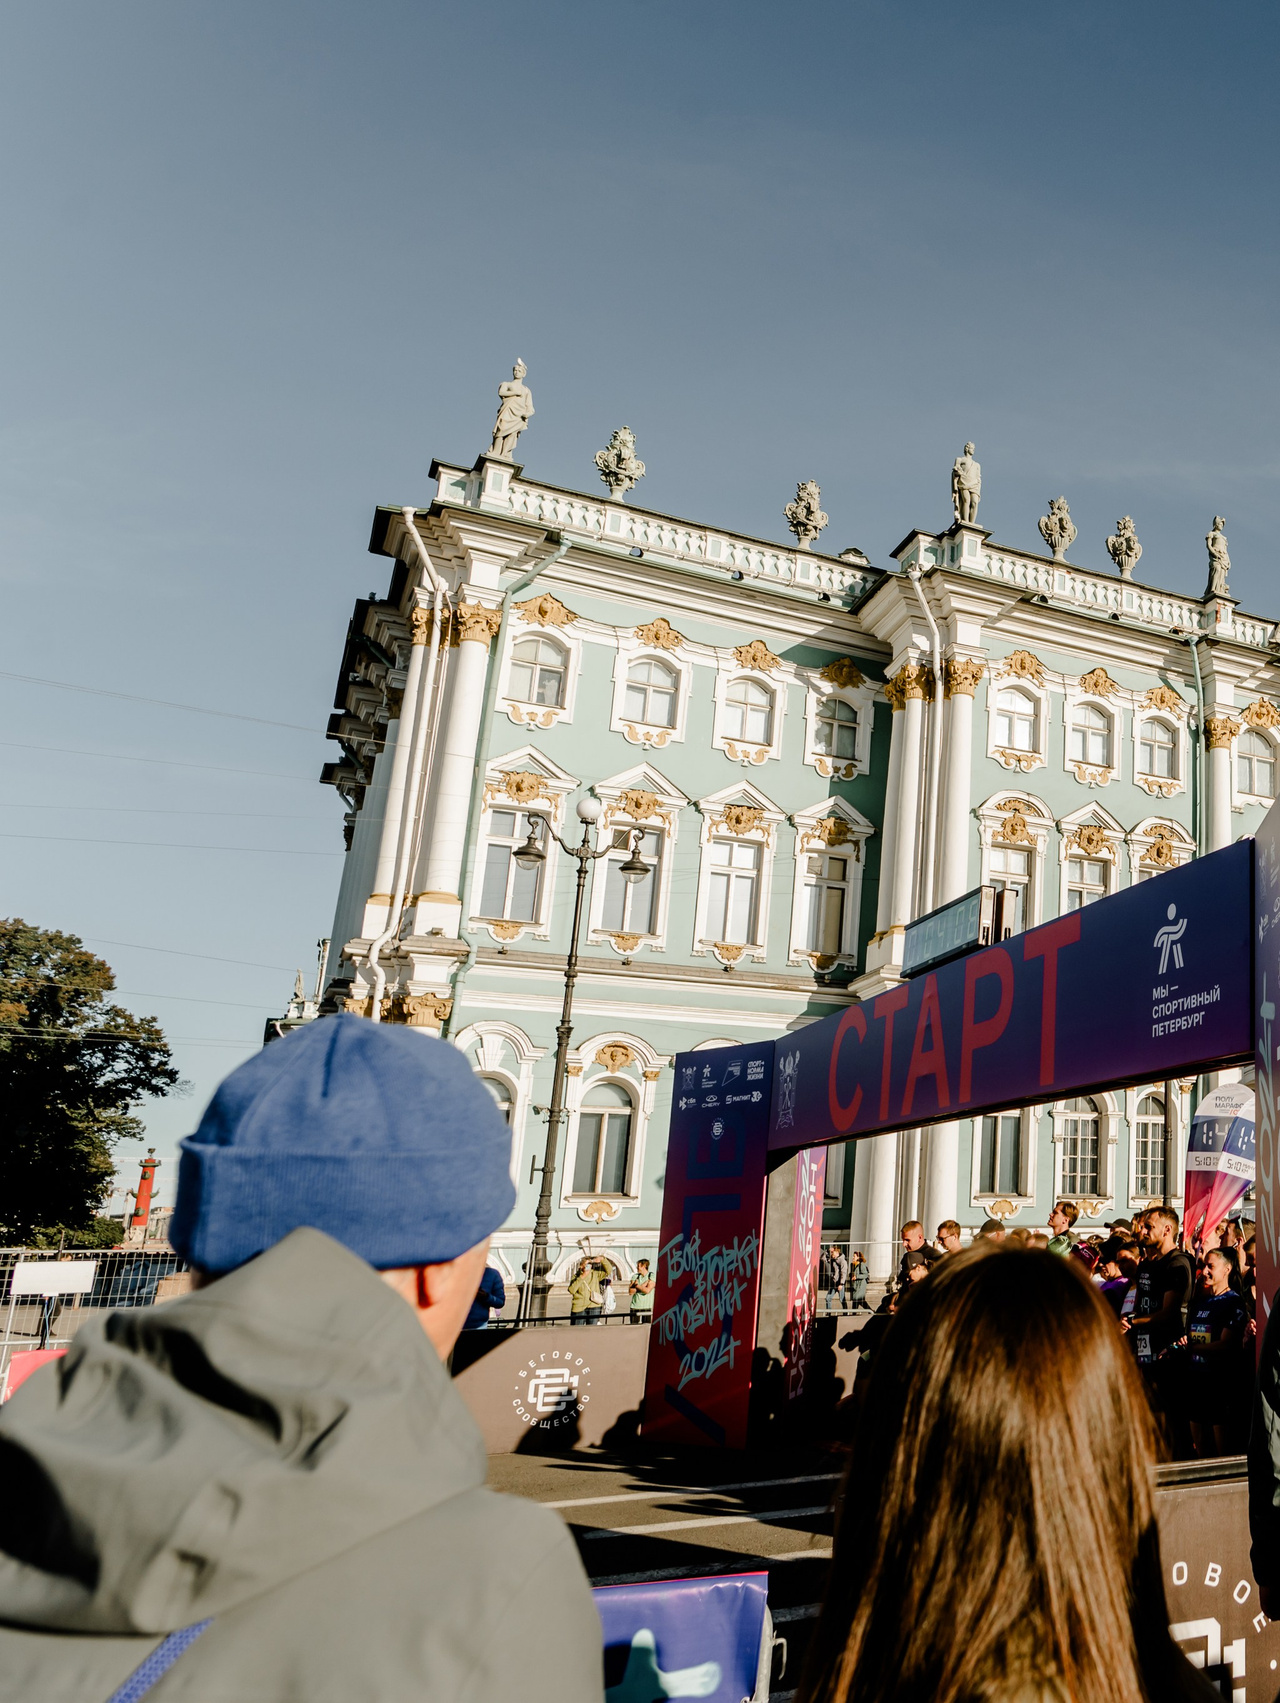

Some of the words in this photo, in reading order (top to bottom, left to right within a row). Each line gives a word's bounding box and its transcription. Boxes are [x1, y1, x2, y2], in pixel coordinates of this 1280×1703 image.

[1152, 984, 1169, 1001] МЫ
[1152, 984, 1220, 1019] СПОРТИВНЫЙ
[828, 912, 1081, 1131] СТАРТ
[1152, 1011, 1205, 1038] ПЕТЕРБУРГ
[1194, 1156, 1212, 1166] 5:10
[1227, 1158, 1242, 1172] 5:10
[518, 1351, 591, 1378] БЕГОВОЕ
[678, 1331, 742, 1391] 2024
[512, 1394, 590, 1430] СООБЩЕСТВО
[1172, 1561, 1272, 1633] ОВОЕ
